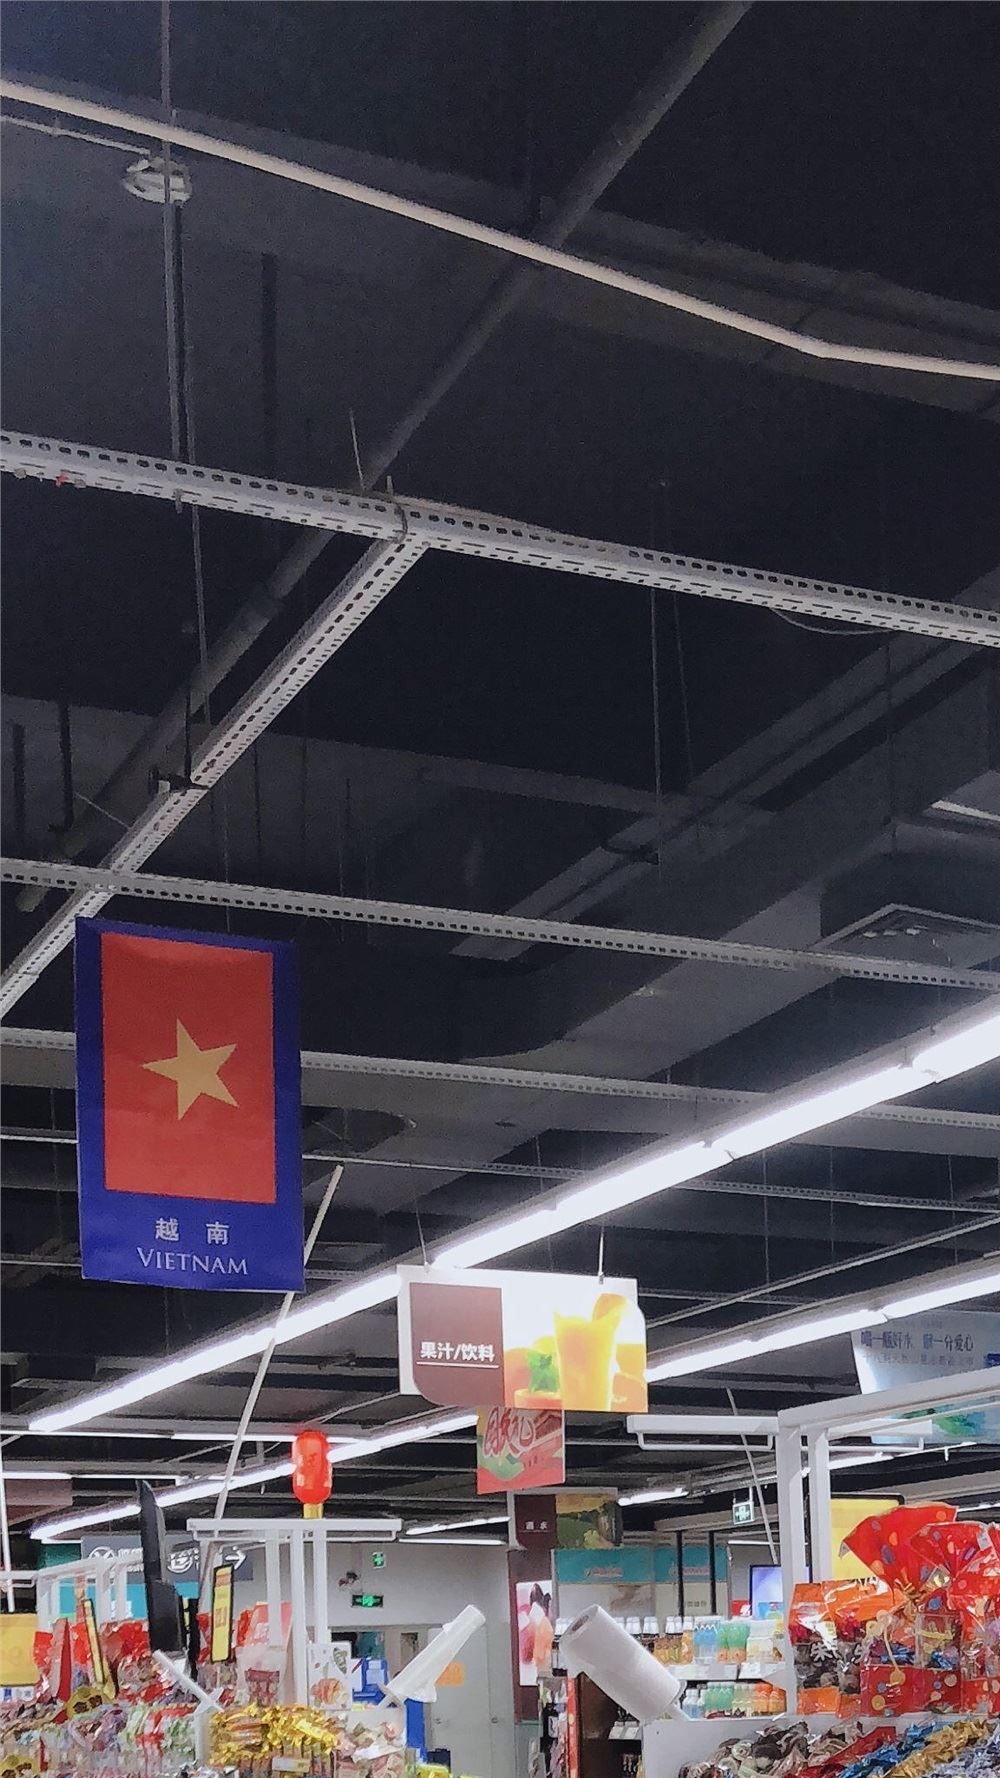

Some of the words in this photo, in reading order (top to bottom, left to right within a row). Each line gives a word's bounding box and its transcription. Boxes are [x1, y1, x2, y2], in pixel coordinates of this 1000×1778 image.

[155, 1218, 229, 1245] 越南
[137, 1247, 248, 1275] VIETNAM
[420, 1341, 495, 1362] 果汁/饮料
